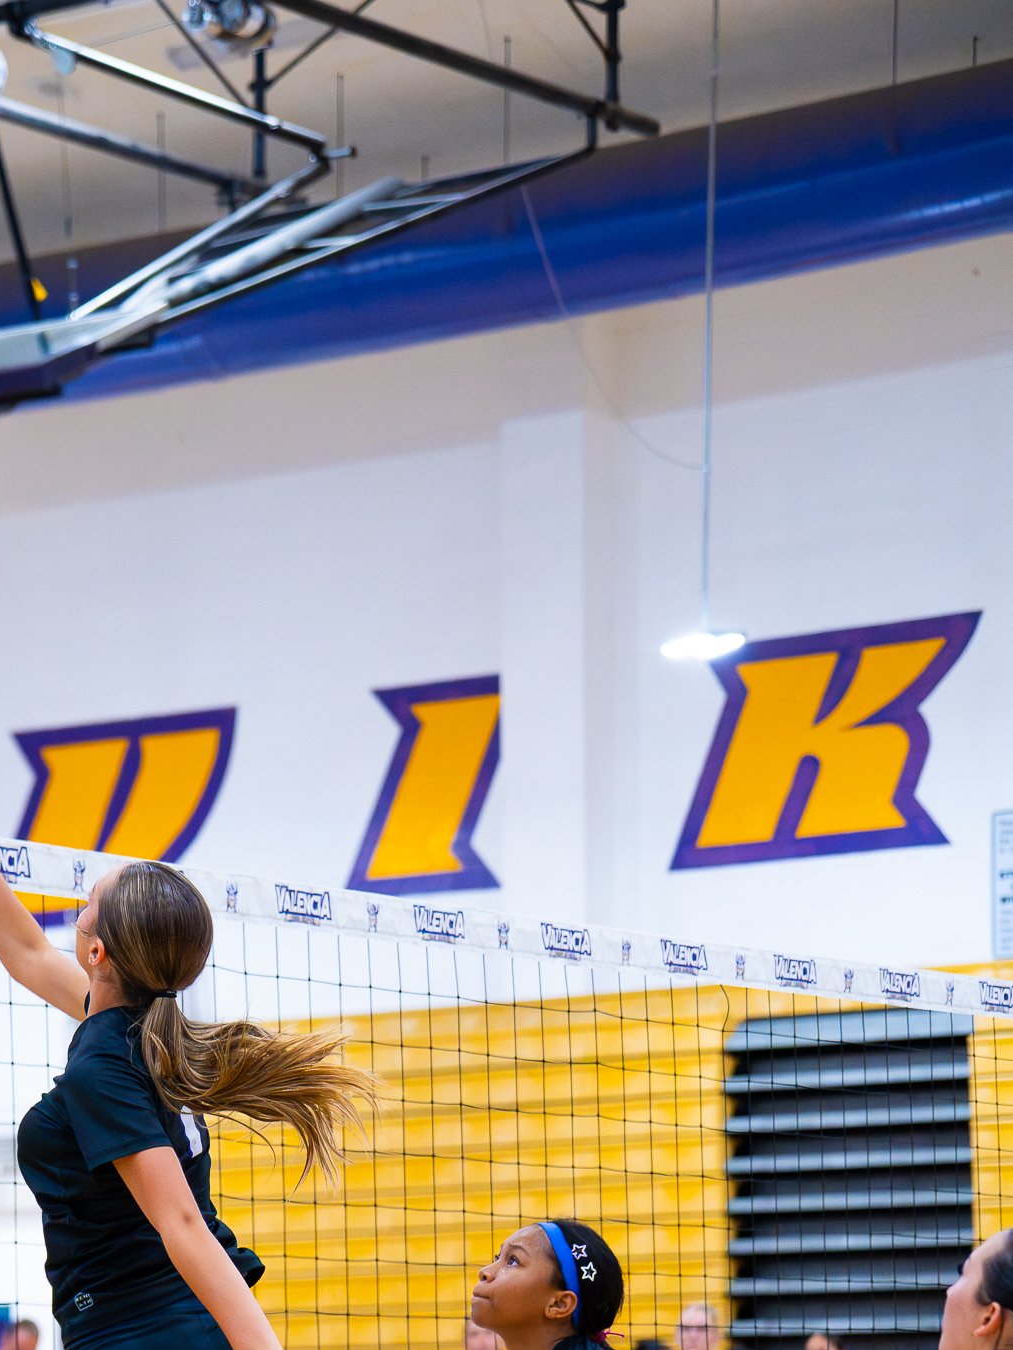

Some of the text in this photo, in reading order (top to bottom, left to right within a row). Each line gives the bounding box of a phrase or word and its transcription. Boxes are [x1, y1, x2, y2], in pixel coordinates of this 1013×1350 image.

[275, 884, 332, 921] VALENCIA
[413, 904, 465, 939] VALENCIA
[540, 922, 592, 956] VALENCIA
[660, 939, 708, 970] VALENCIA
[773, 954, 817, 984] VALENCIA
[879, 967, 920, 997] VALENCIA
